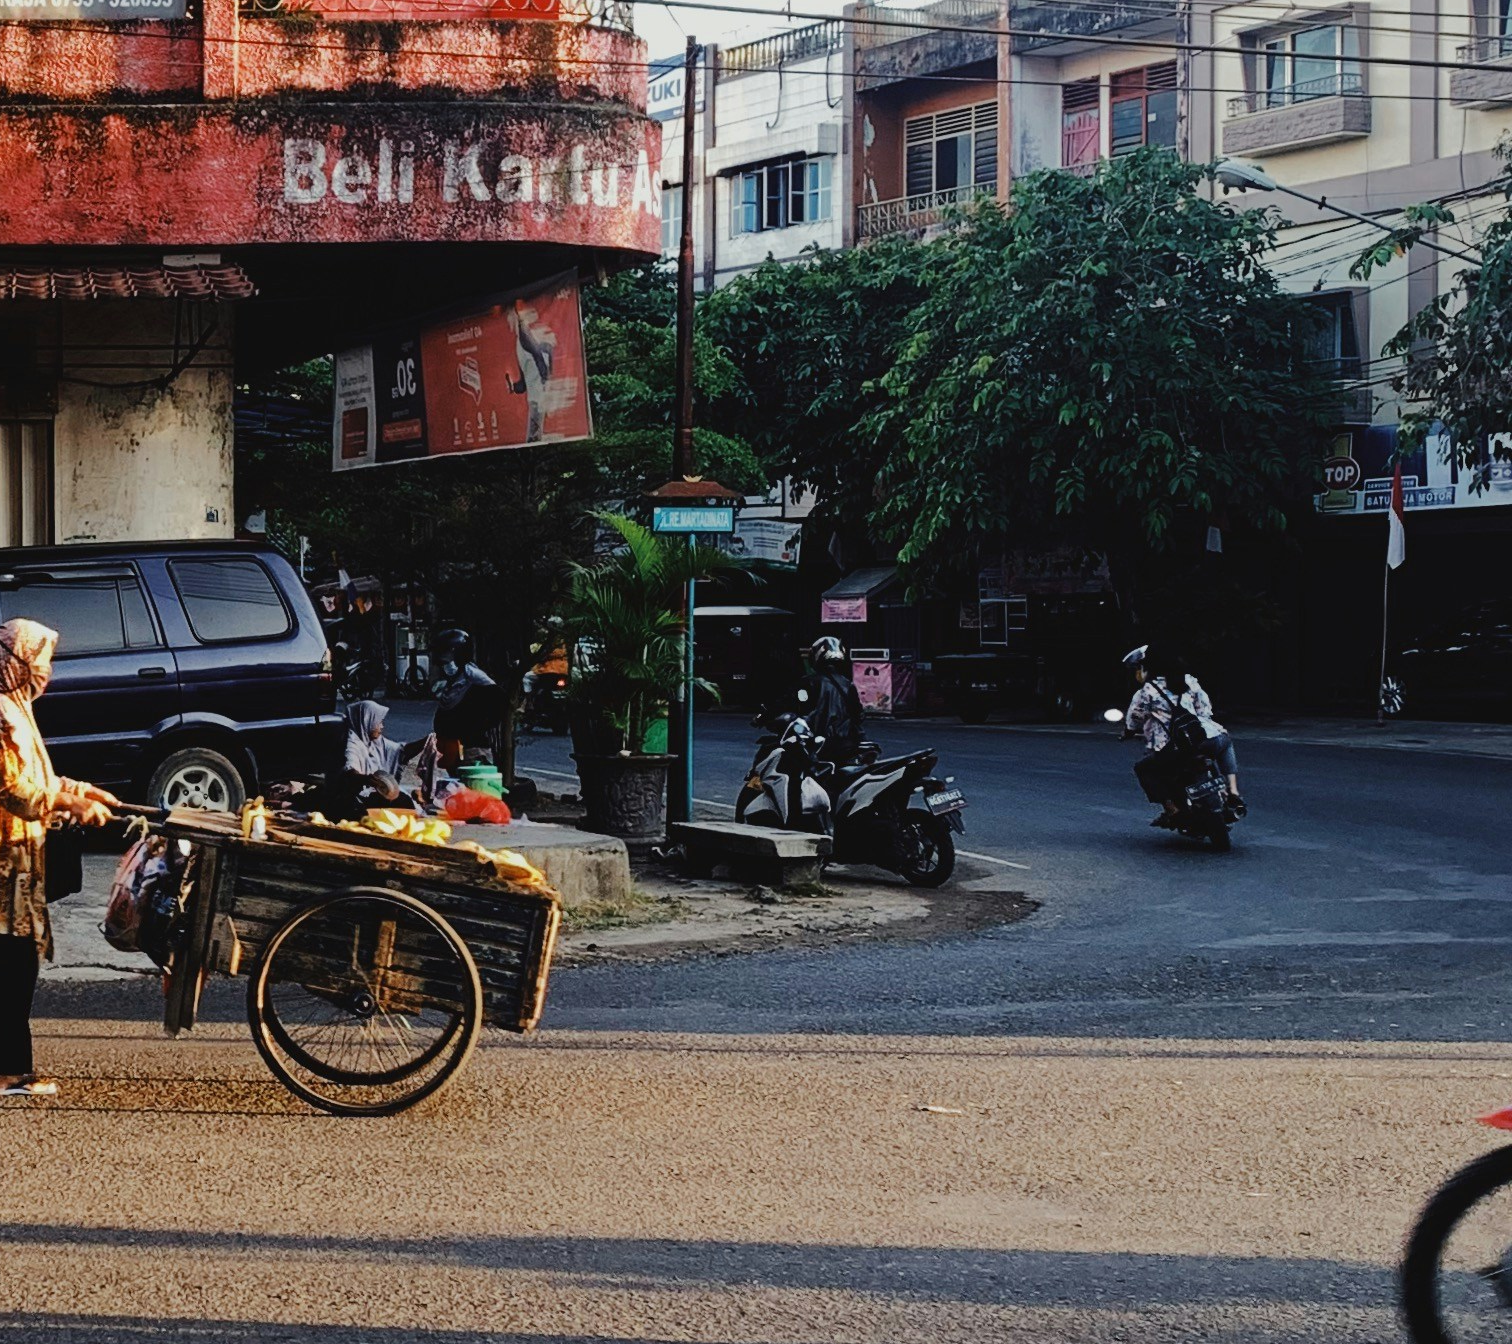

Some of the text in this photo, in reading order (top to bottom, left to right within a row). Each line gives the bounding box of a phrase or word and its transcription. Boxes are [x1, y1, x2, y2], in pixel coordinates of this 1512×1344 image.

[283, 138, 415, 205] Beli
[442, 139, 619, 208] Kartu
[1325, 467, 1354, 482] TOP
[1367, 494, 1414, 506] BATUJA
[1418, 490, 1453, 503] MOTOR
